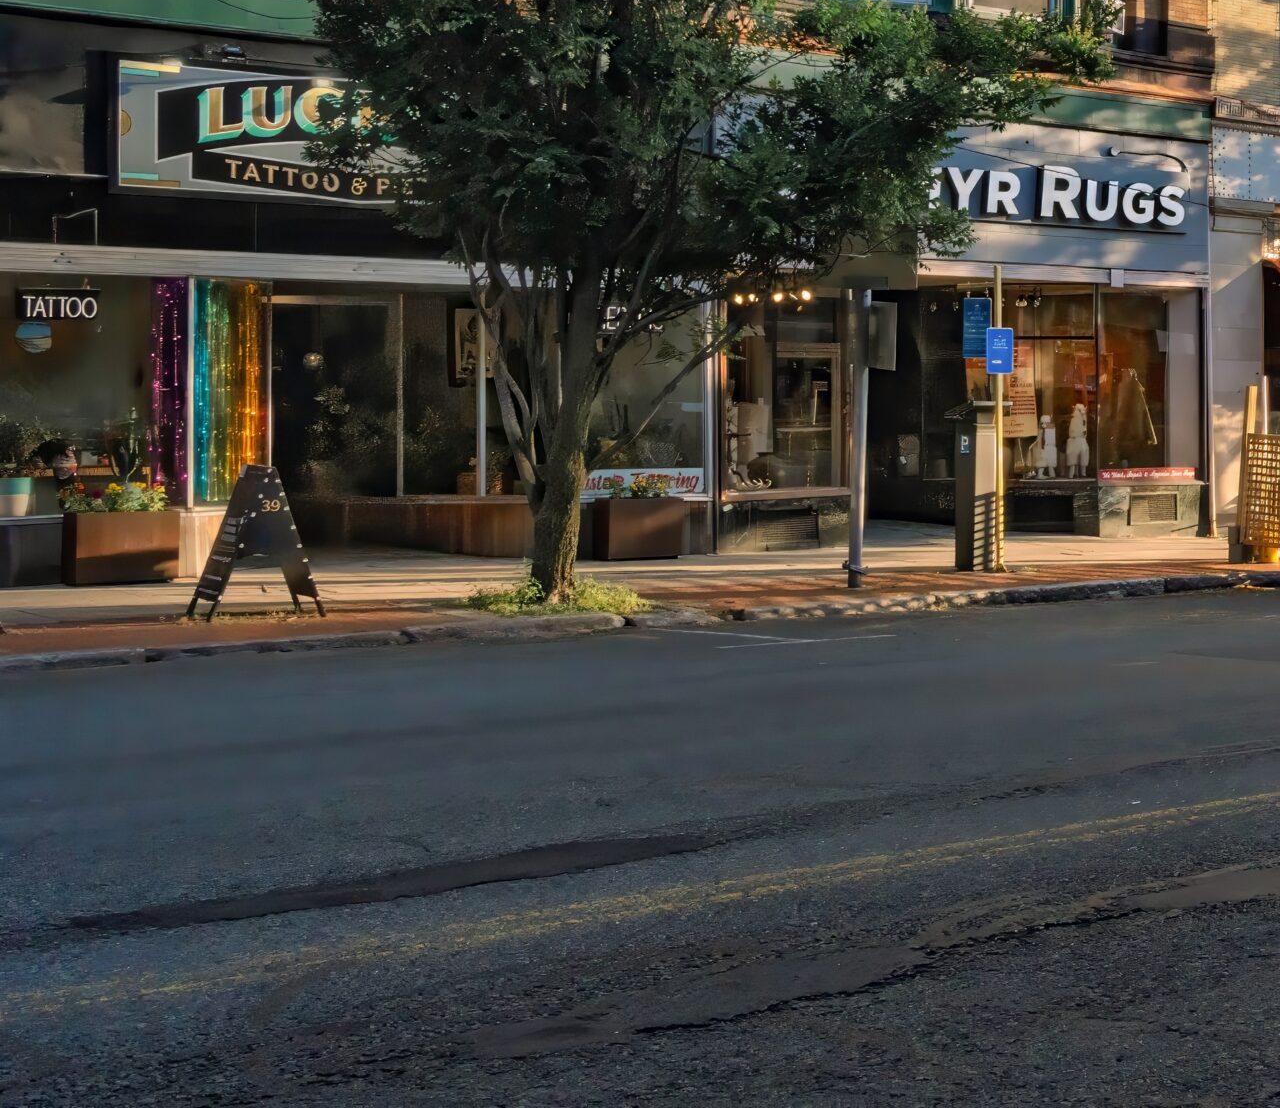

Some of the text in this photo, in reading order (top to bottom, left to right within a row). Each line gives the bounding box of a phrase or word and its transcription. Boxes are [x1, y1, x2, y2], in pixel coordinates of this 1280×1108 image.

[225, 158, 341, 192] TATTOO
[351, 177, 368, 196] &
[1040, 164, 1186, 227] RUGS
[22, 295, 98, 319] TATTOO
[261, 499, 281, 512] 39
